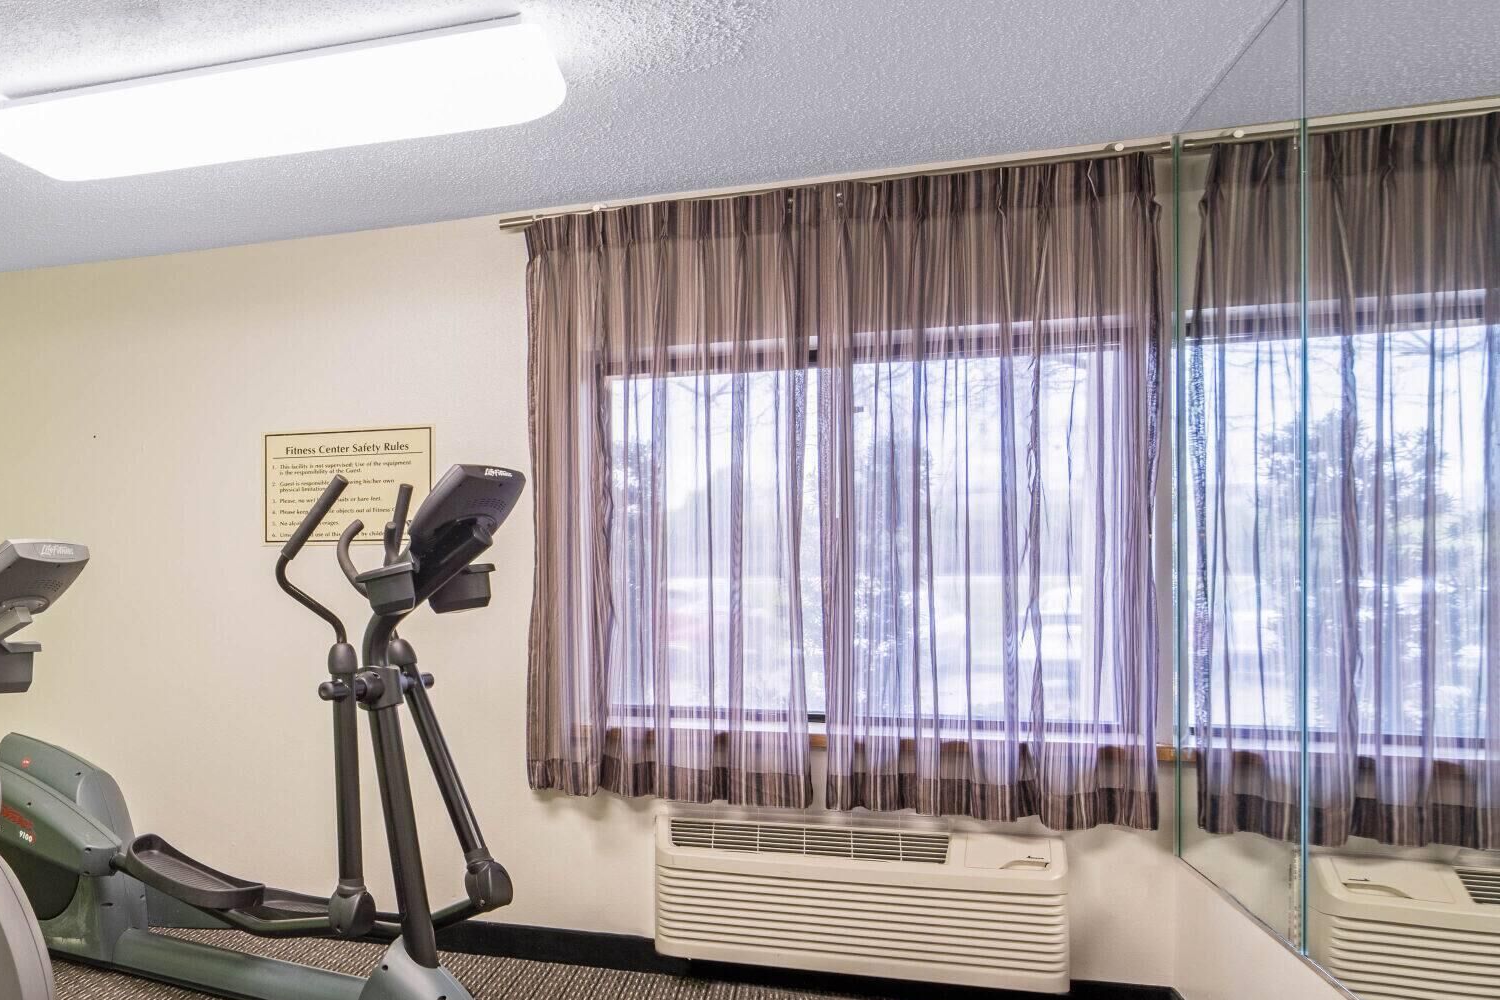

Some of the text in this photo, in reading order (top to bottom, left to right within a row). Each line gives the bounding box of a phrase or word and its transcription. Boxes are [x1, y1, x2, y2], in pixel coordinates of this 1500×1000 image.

[285, 441, 409, 455] Fitness Center Safety Rules
